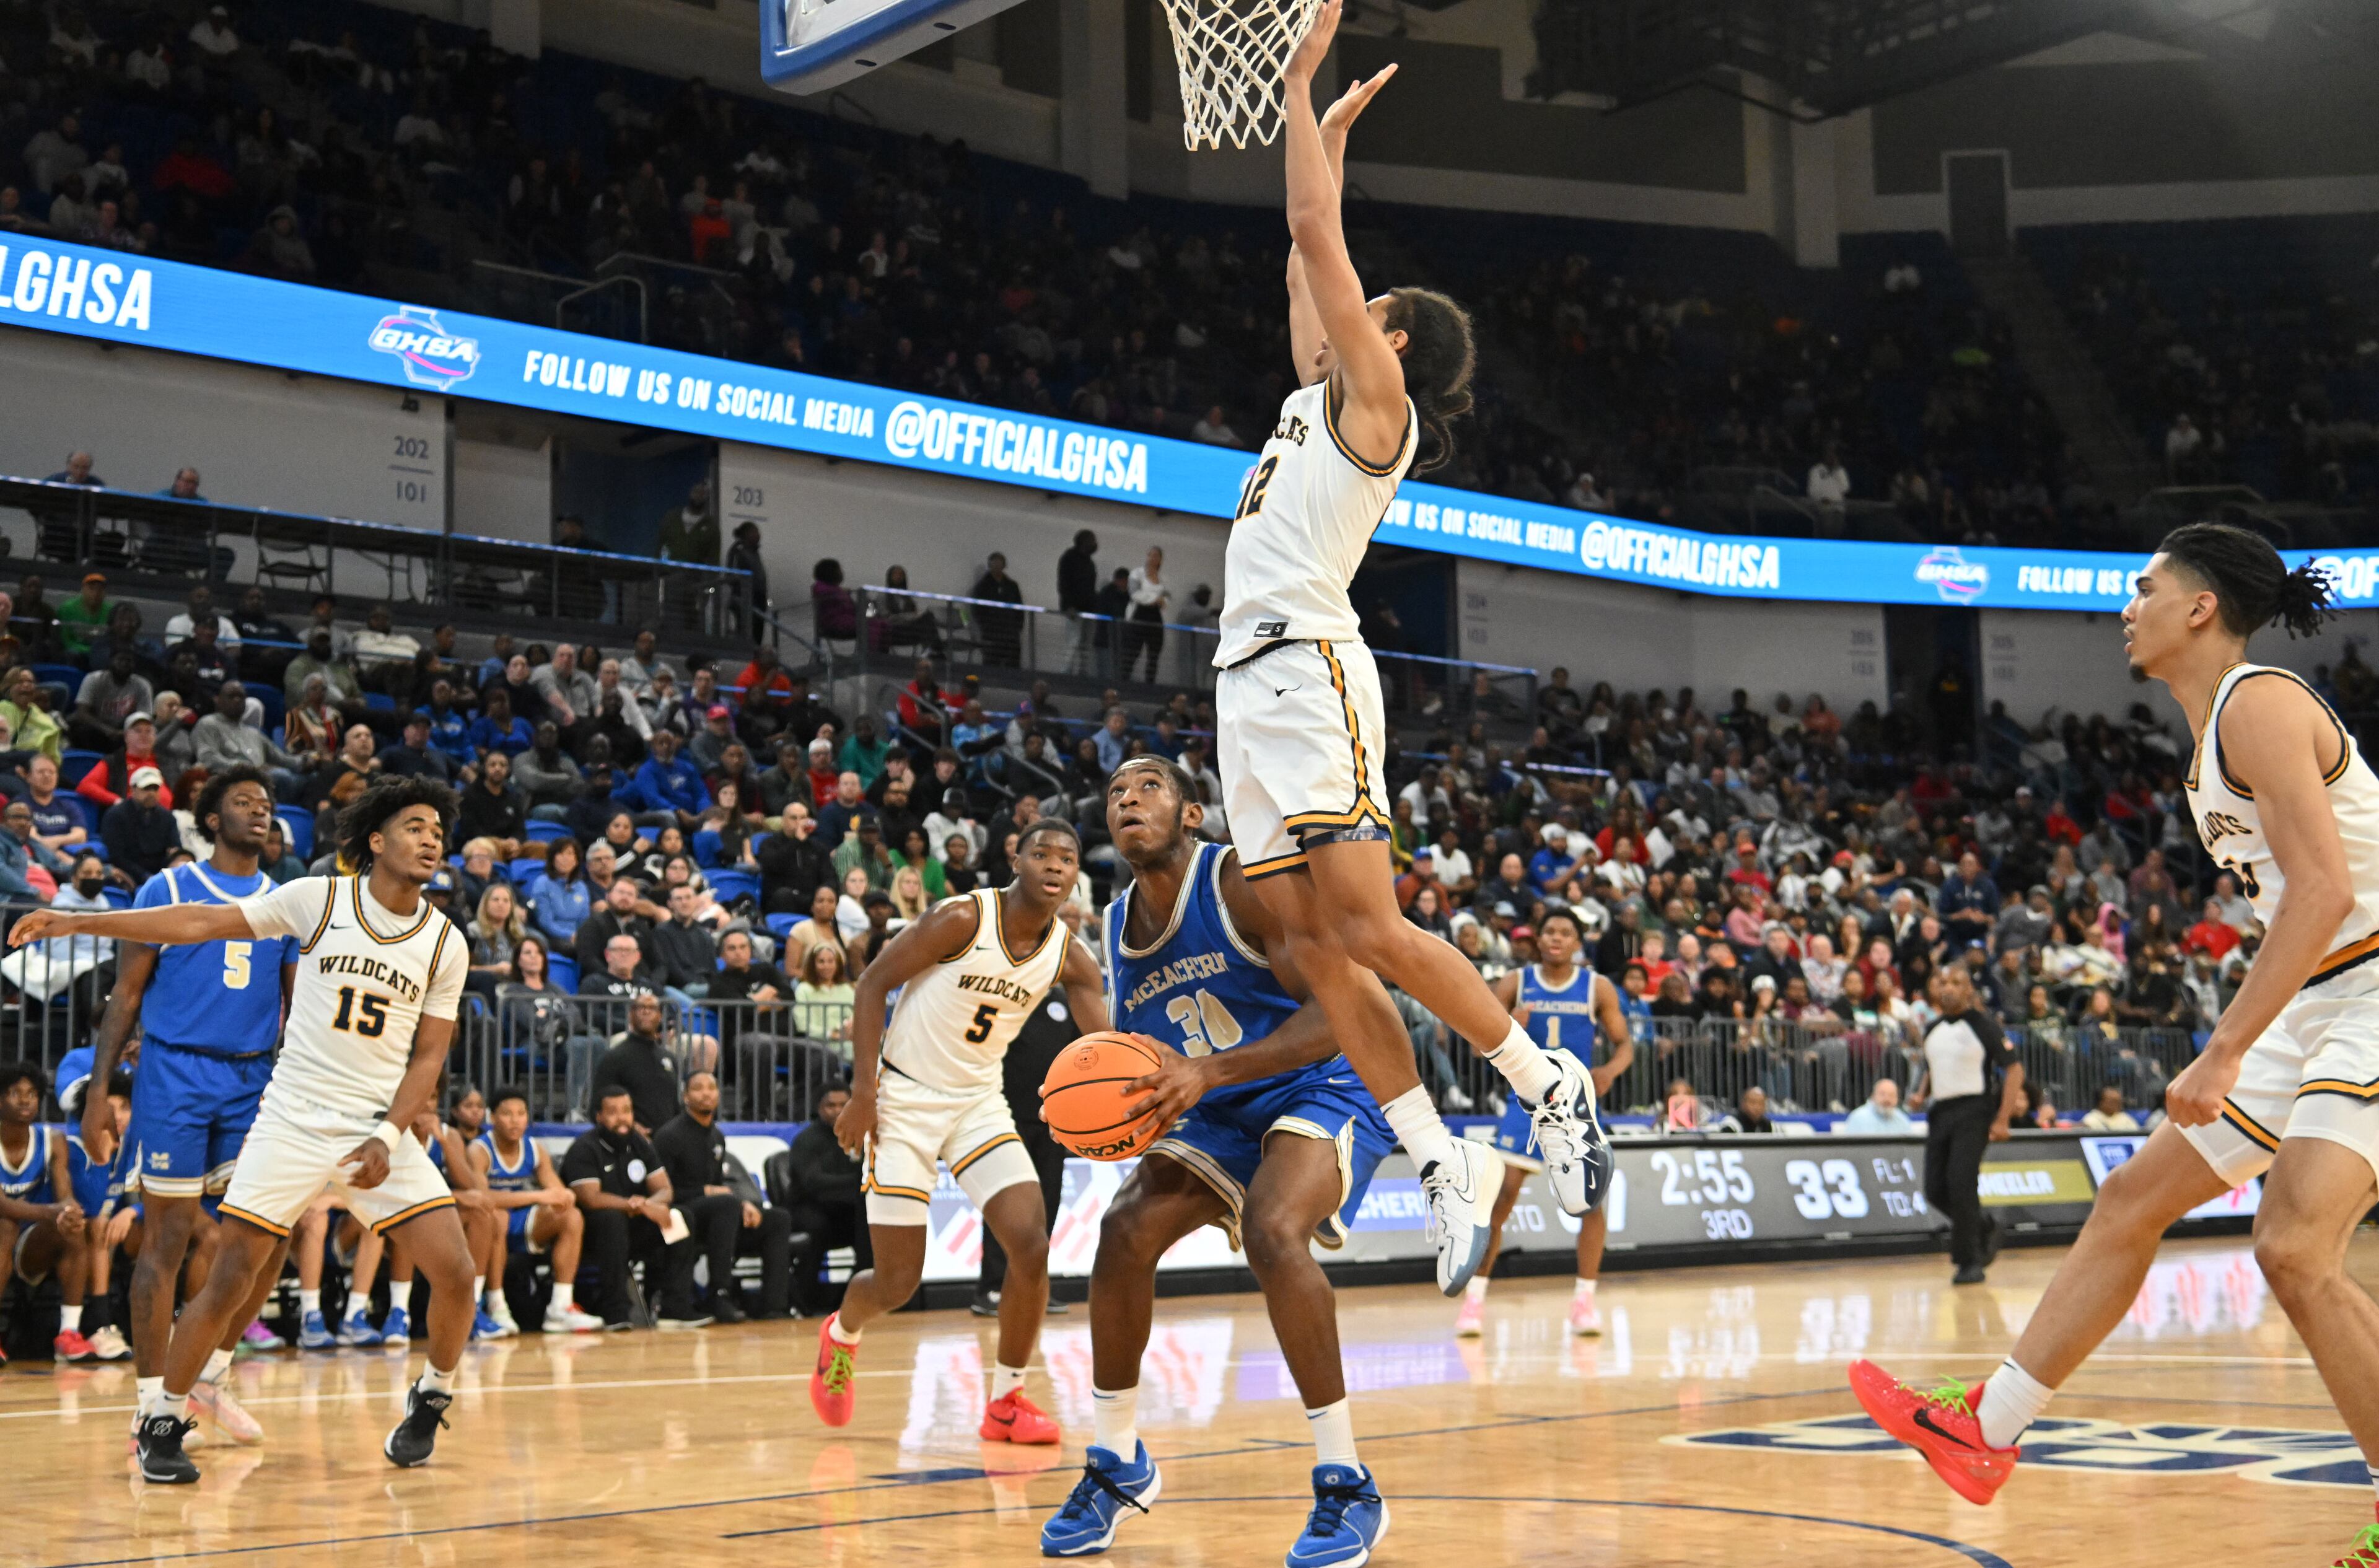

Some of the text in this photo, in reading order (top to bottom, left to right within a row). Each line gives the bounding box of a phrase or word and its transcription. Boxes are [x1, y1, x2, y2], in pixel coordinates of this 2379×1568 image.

[373, 328, 473, 362] GHSA
[523, 350, 1149, 493] FOLLOW US ON SOCIAL MEDIA @OFFICIALGHSA
[393, 436, 430, 460] 202
[396, 482, 427, 503] 101
[733, 486, 764, 507] 203
[1414, 502, 1440, 532] US
[1441, 507, 1466, 536] ON
[1466, 511, 1523, 546] SOCIAL
[1525, 521, 1575, 554] MEDIA
[1580, 520, 1780, 589] @OFFICIALGHSA
[2017, 565, 2095, 595] FOLLOW
[2096, 569, 2124, 596] US
[223, 940, 252, 989] 5
[319, 955, 420, 1002] WILDCATS
[958, 974, 1033, 1008] WILDCATS
[332, 984, 391, 1039] 15
[964, 1003, 1000, 1045] 5
[1165, 988, 1244, 1059] 30
[1546, 1015, 1561, 1048] 1
[1074, 1134, 1136, 1157] NCAA
[1651, 1149, 1755, 1206] 2:55
[1785, 1158, 1869, 1220] 33
[1701, 1209, 1755, 1240] 3RD
